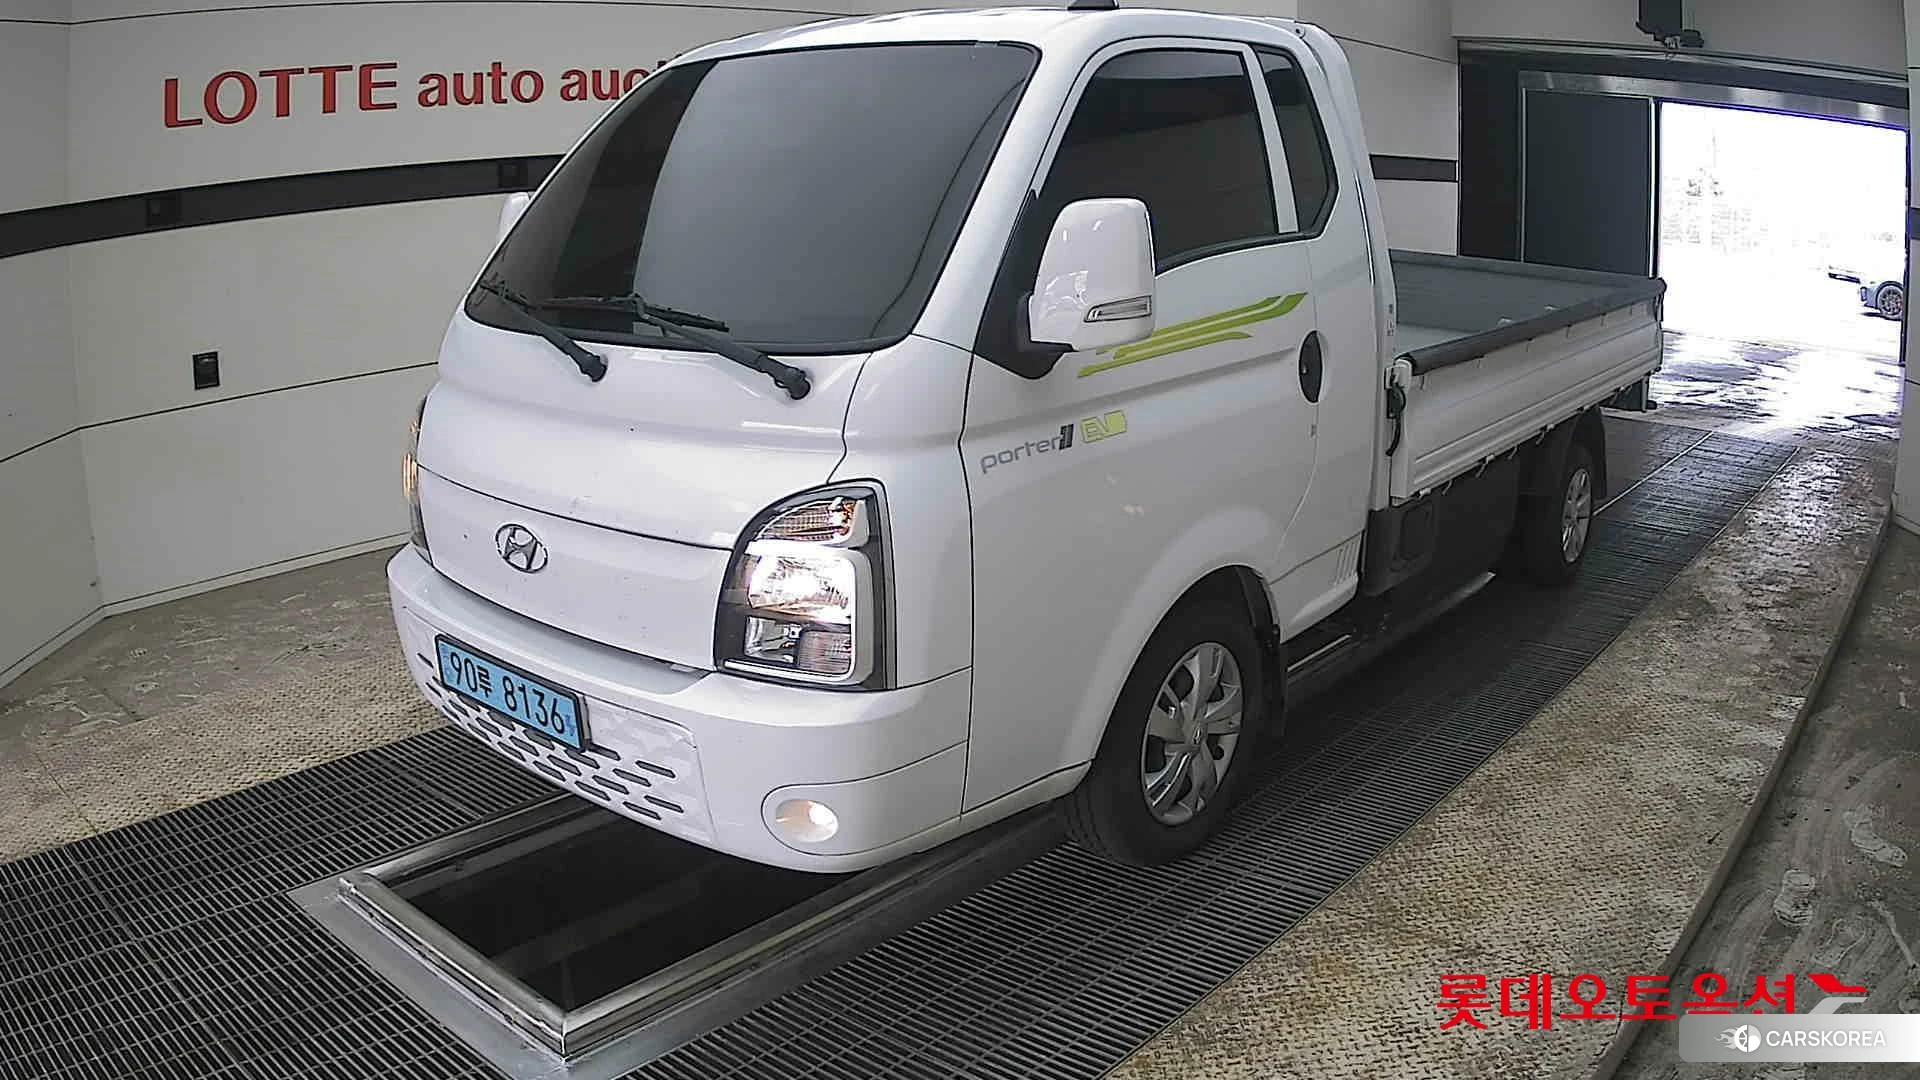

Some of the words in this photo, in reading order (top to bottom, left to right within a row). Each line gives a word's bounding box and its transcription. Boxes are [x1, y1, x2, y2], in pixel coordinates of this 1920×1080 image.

[164, 62, 398, 128] LOTTE
[417, 61, 545, 107] auto
[502, 675, 565, 734] 8136
